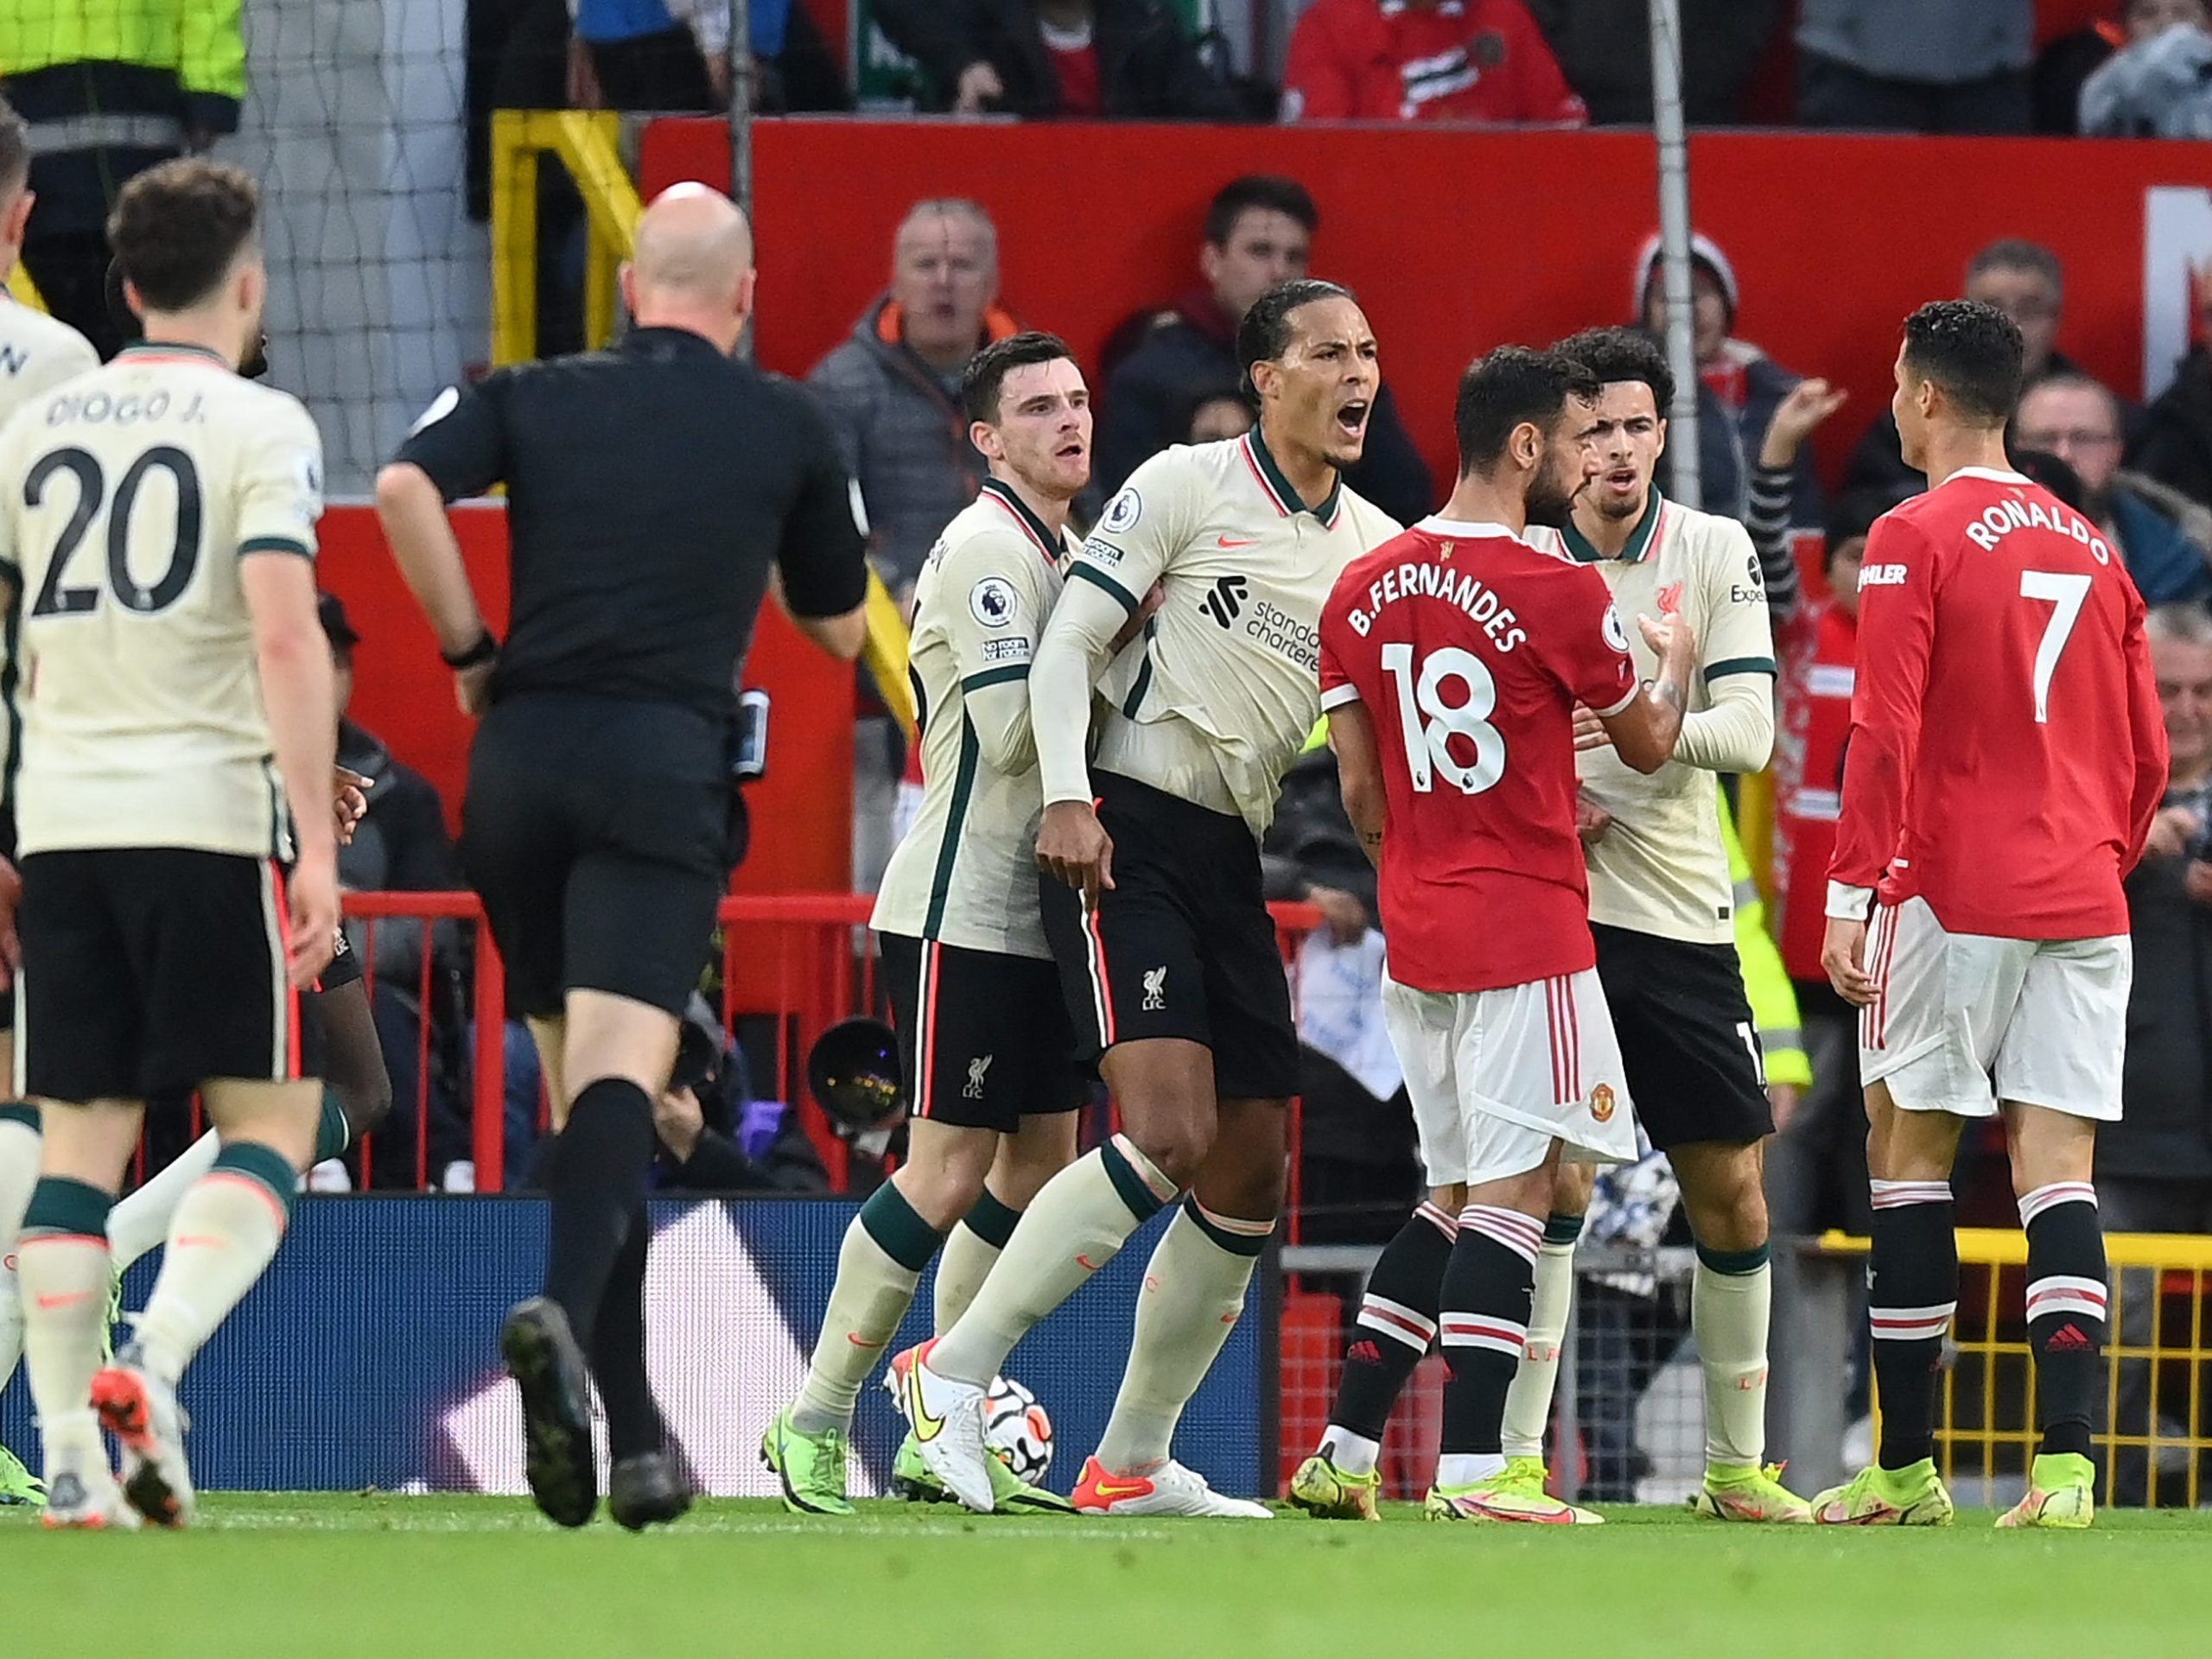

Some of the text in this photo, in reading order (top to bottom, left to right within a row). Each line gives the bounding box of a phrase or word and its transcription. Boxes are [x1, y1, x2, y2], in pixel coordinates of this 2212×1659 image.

[47, 389, 170, 427] DIOGO
[23, 446, 204, 618] 20
[1965, 499, 2110, 566] RONALDO
[1347, 563, 1527, 653] B.FERNANDES
[2019, 569, 2093, 723] 7
[1381, 643, 1506, 795] 18
